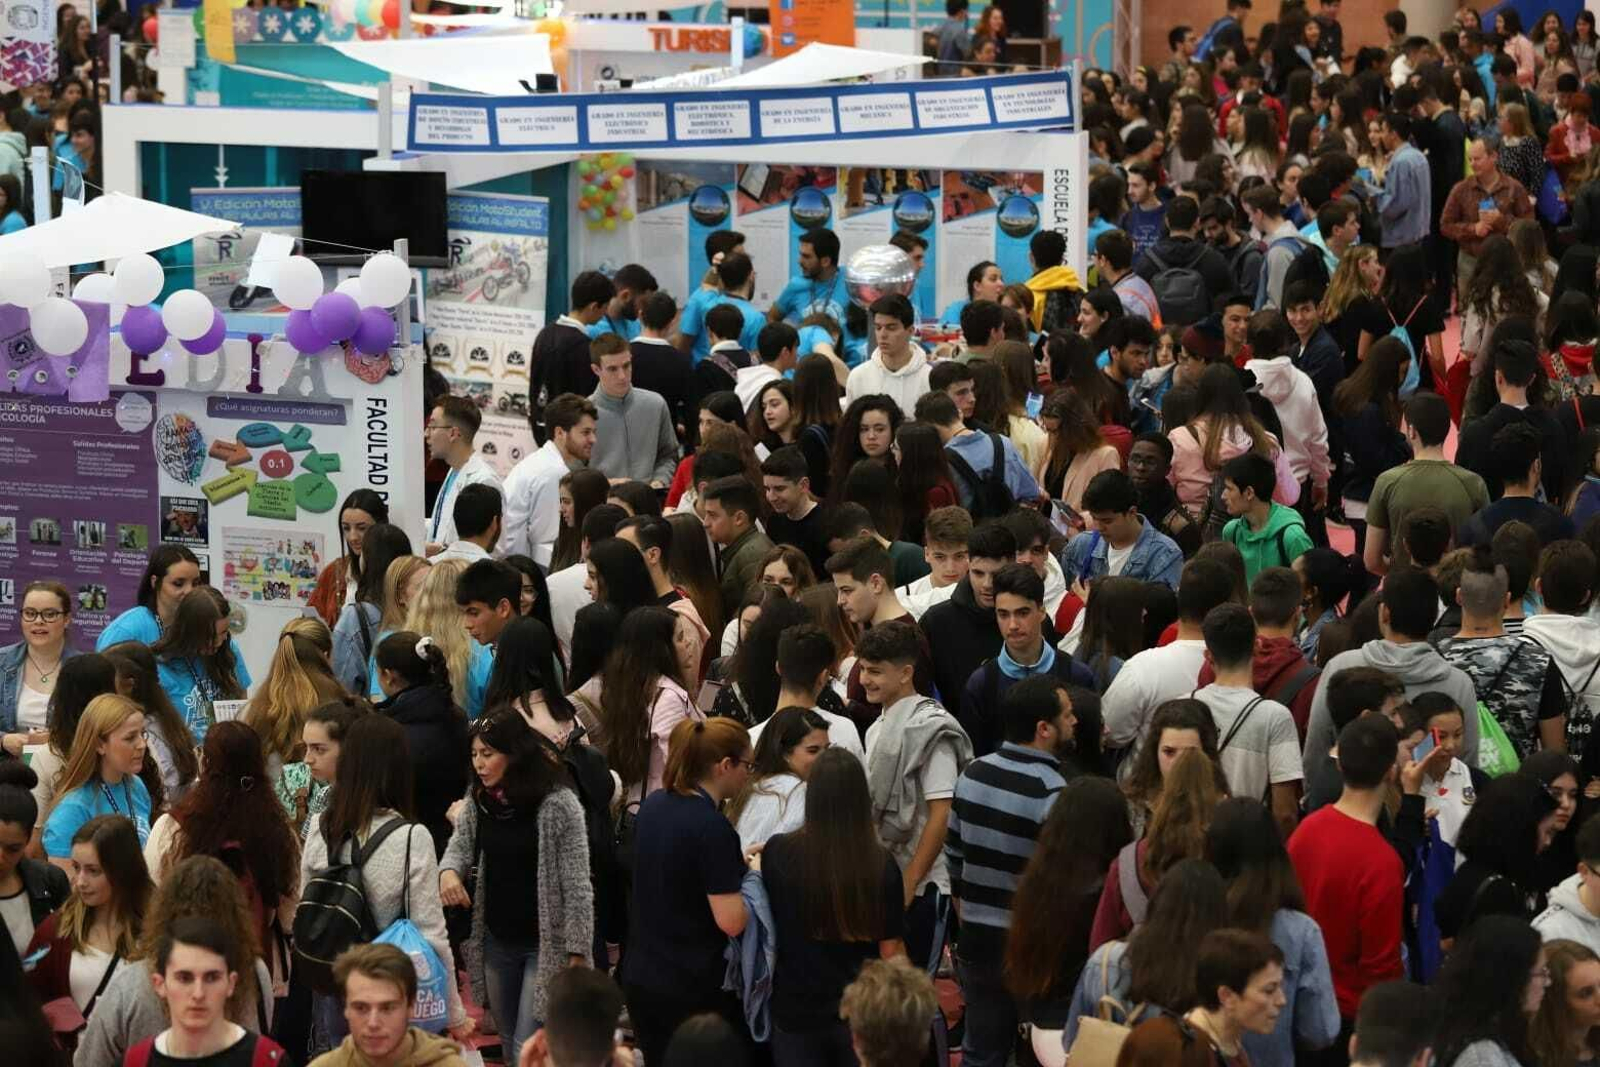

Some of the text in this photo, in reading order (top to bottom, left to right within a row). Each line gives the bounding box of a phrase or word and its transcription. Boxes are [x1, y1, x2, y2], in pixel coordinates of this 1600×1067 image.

[648, 27, 731, 53] TURIS
[1054, 169, 1069, 224] ESCUELA
[30, 404, 114, 418] PROFESIONALES
[241, 404, 290, 415] asignaturas
[1, 412, 46, 424] COLOGÍA
[367, 397, 388, 486] FACULTAD
[268, 459, 284, 468] 0.1
[413, 999, 446, 1018] UEGO
